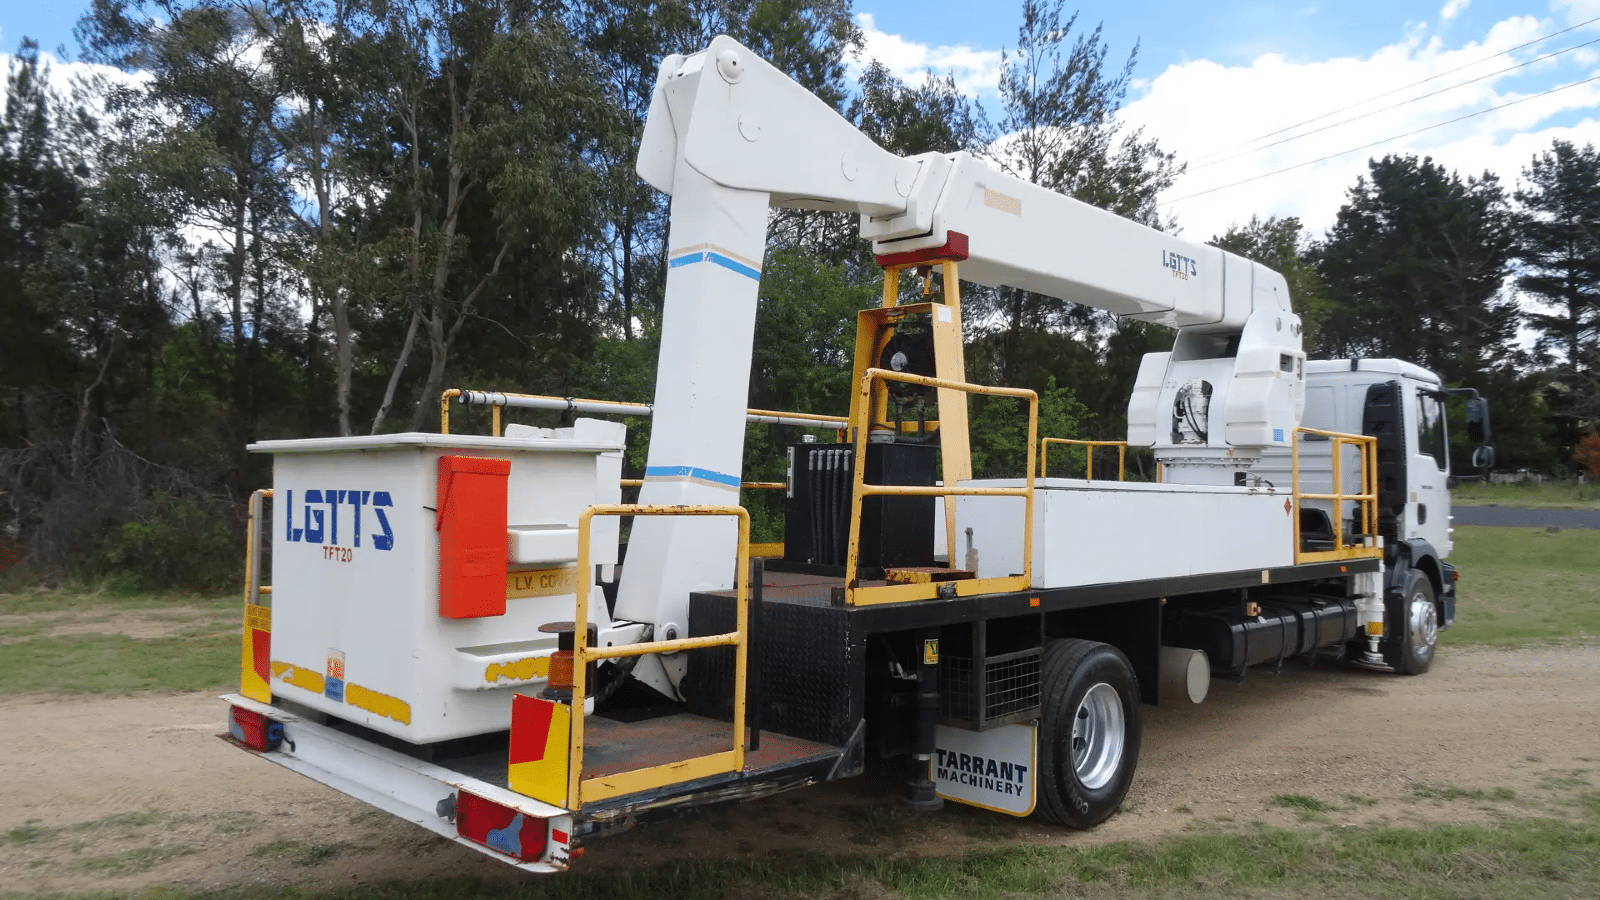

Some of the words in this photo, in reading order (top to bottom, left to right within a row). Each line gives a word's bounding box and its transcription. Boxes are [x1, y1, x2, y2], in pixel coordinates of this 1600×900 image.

[1162, 249, 1197, 276] LGTTS
[286, 489, 394, 551] LGTTS
[322, 545, 353, 563] TFT20
[935, 748, 1028, 783] TARRANT
[937, 767, 1023, 797] MACHINERY
